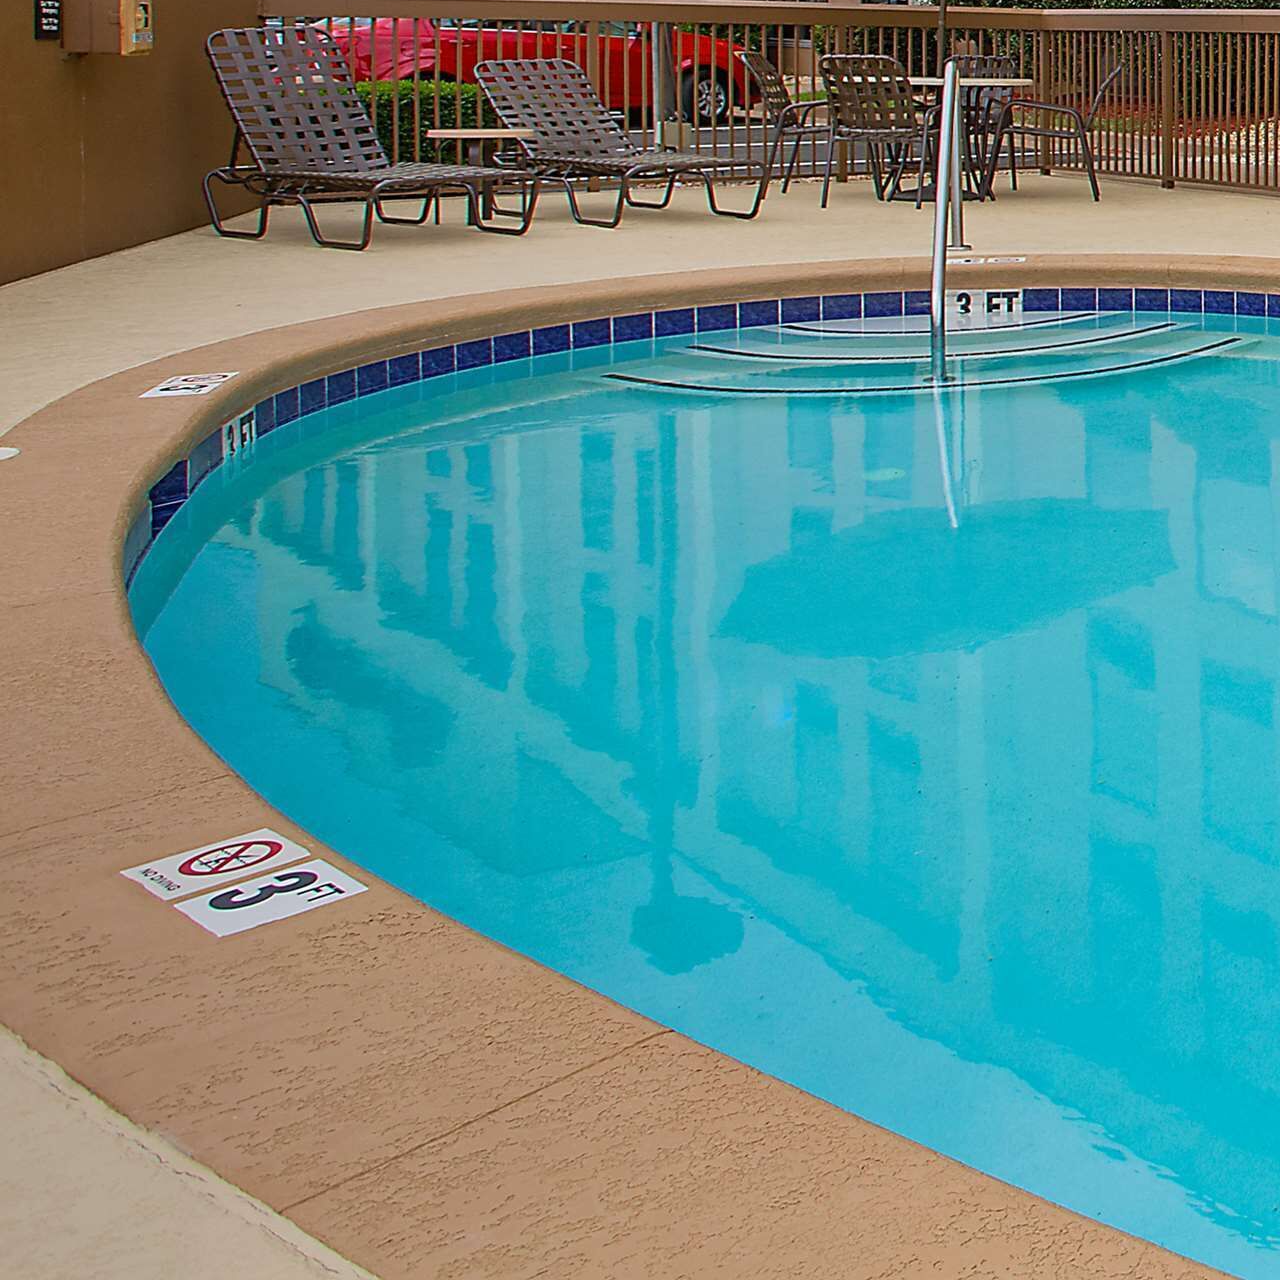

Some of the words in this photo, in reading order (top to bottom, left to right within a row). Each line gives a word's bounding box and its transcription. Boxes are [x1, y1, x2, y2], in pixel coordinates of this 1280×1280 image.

[956, 292, 971, 315] 3
[986, 291, 1019, 313] FT
[150, 874, 182, 892] DIVING
[208, 870, 318, 910] 3
[297, 882, 346, 903] FT
